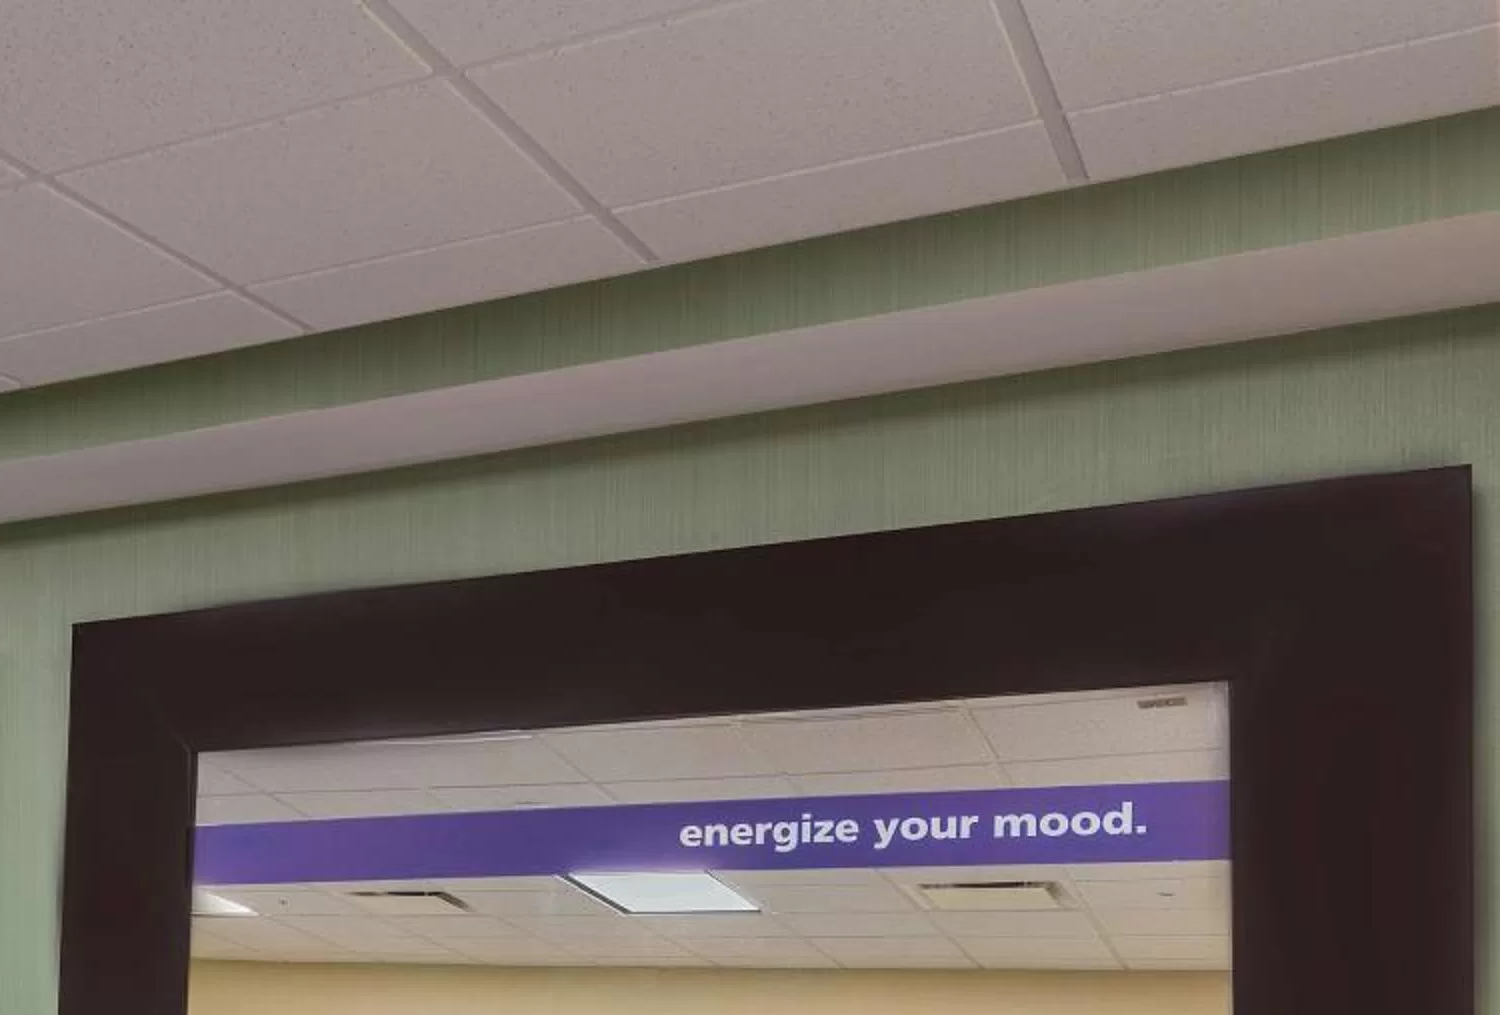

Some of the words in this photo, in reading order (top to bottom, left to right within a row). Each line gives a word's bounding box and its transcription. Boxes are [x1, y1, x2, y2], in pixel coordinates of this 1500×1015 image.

[679, 813, 860, 853] energize
[873, 814, 979, 849] your
[994, 801, 1147, 839] mood.
